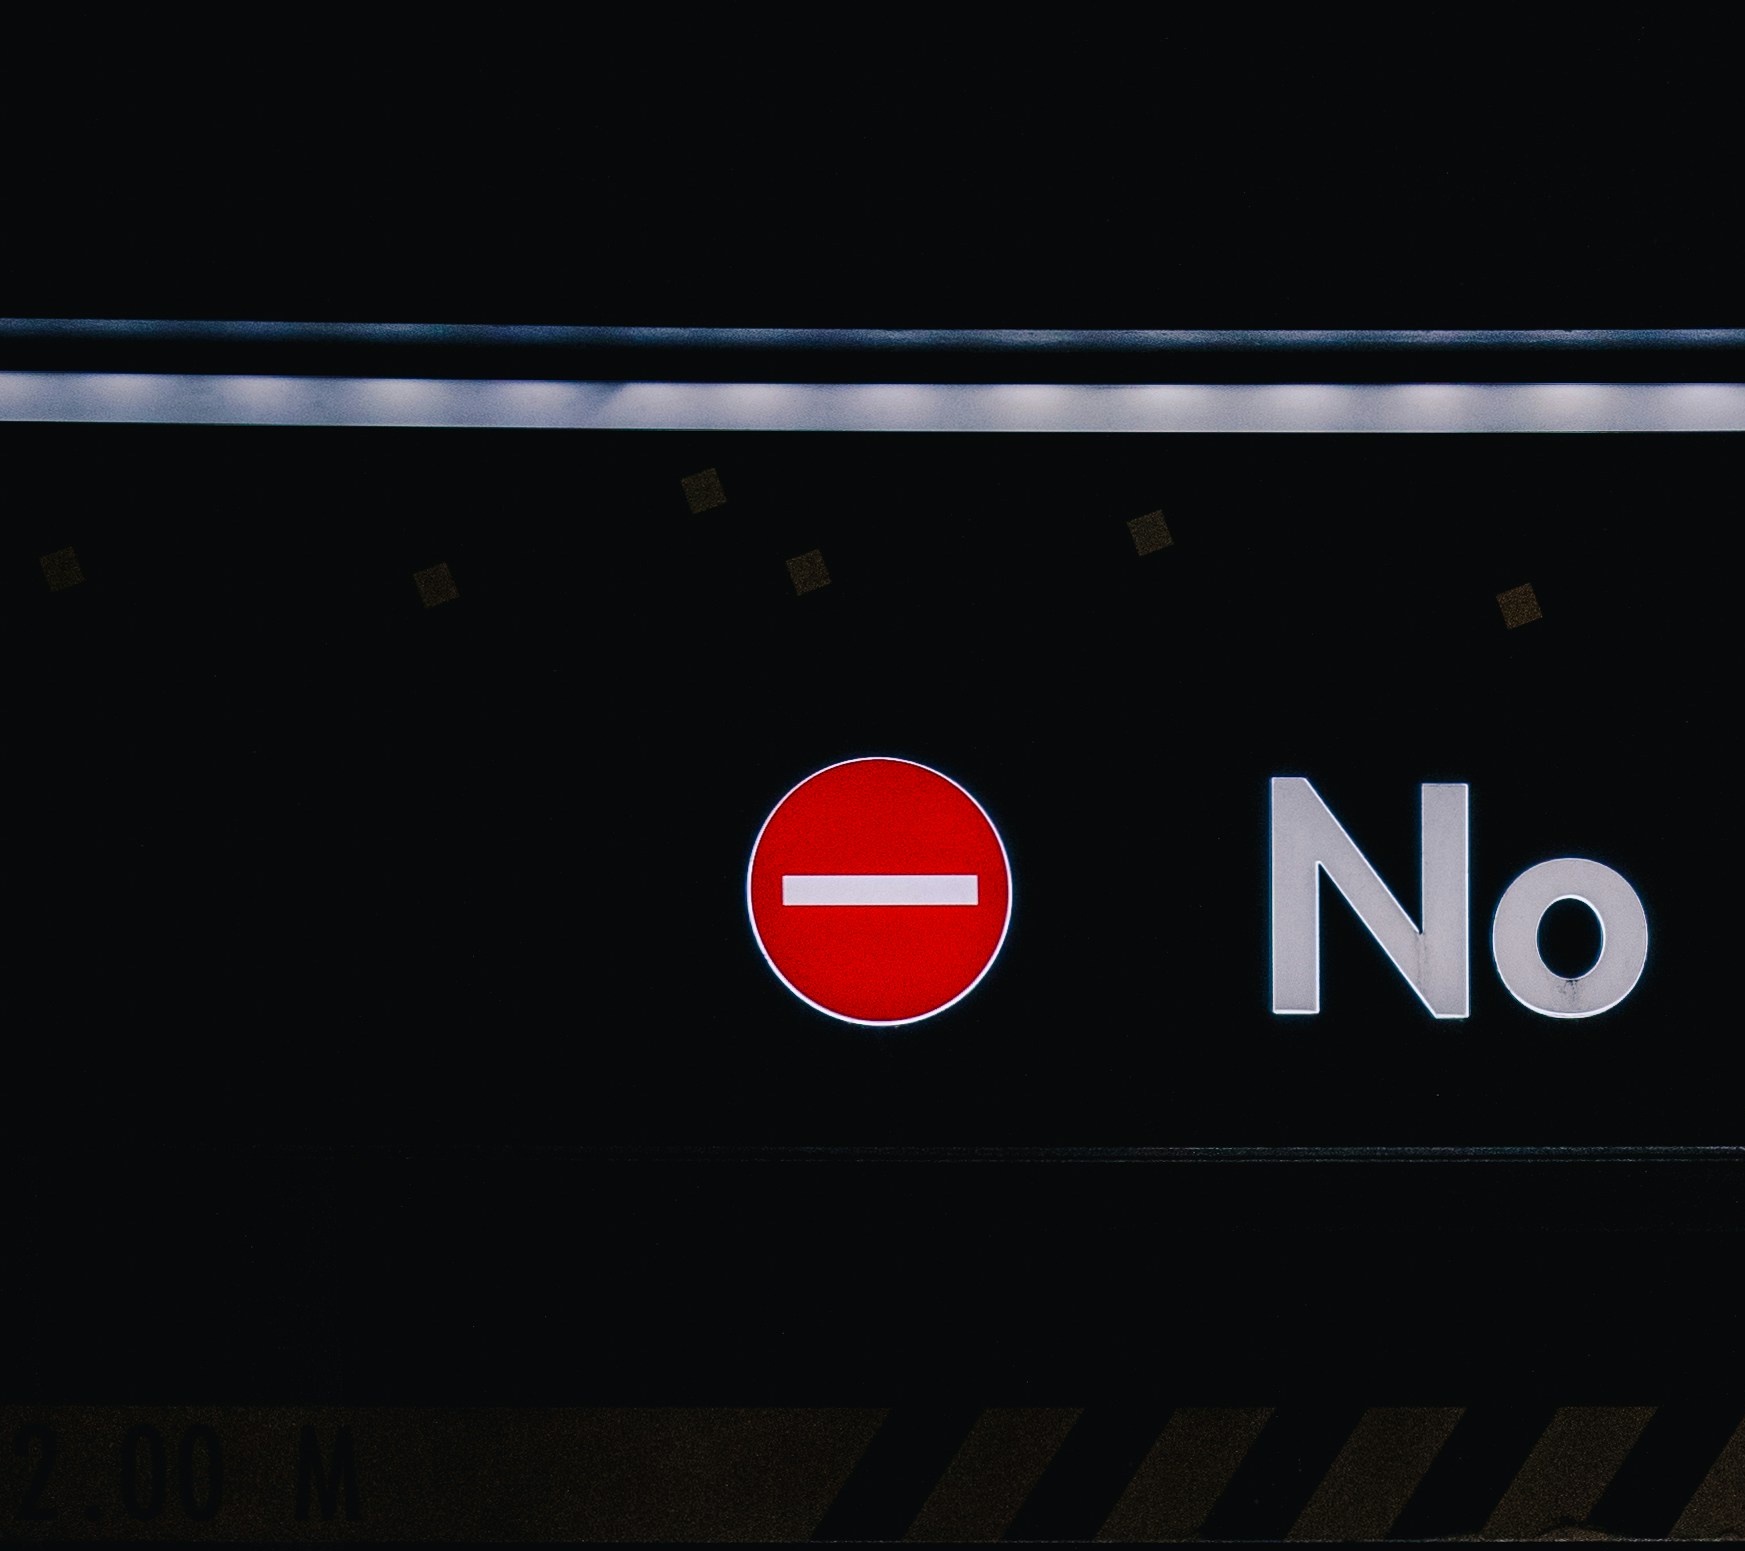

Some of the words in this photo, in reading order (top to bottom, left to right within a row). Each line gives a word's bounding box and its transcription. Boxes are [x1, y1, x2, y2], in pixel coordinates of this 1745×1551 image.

[1269, 776, 1649, 1020] No
[12, 1424, 224, 1522] 2.00
[294, 1424, 364, 1522] M
